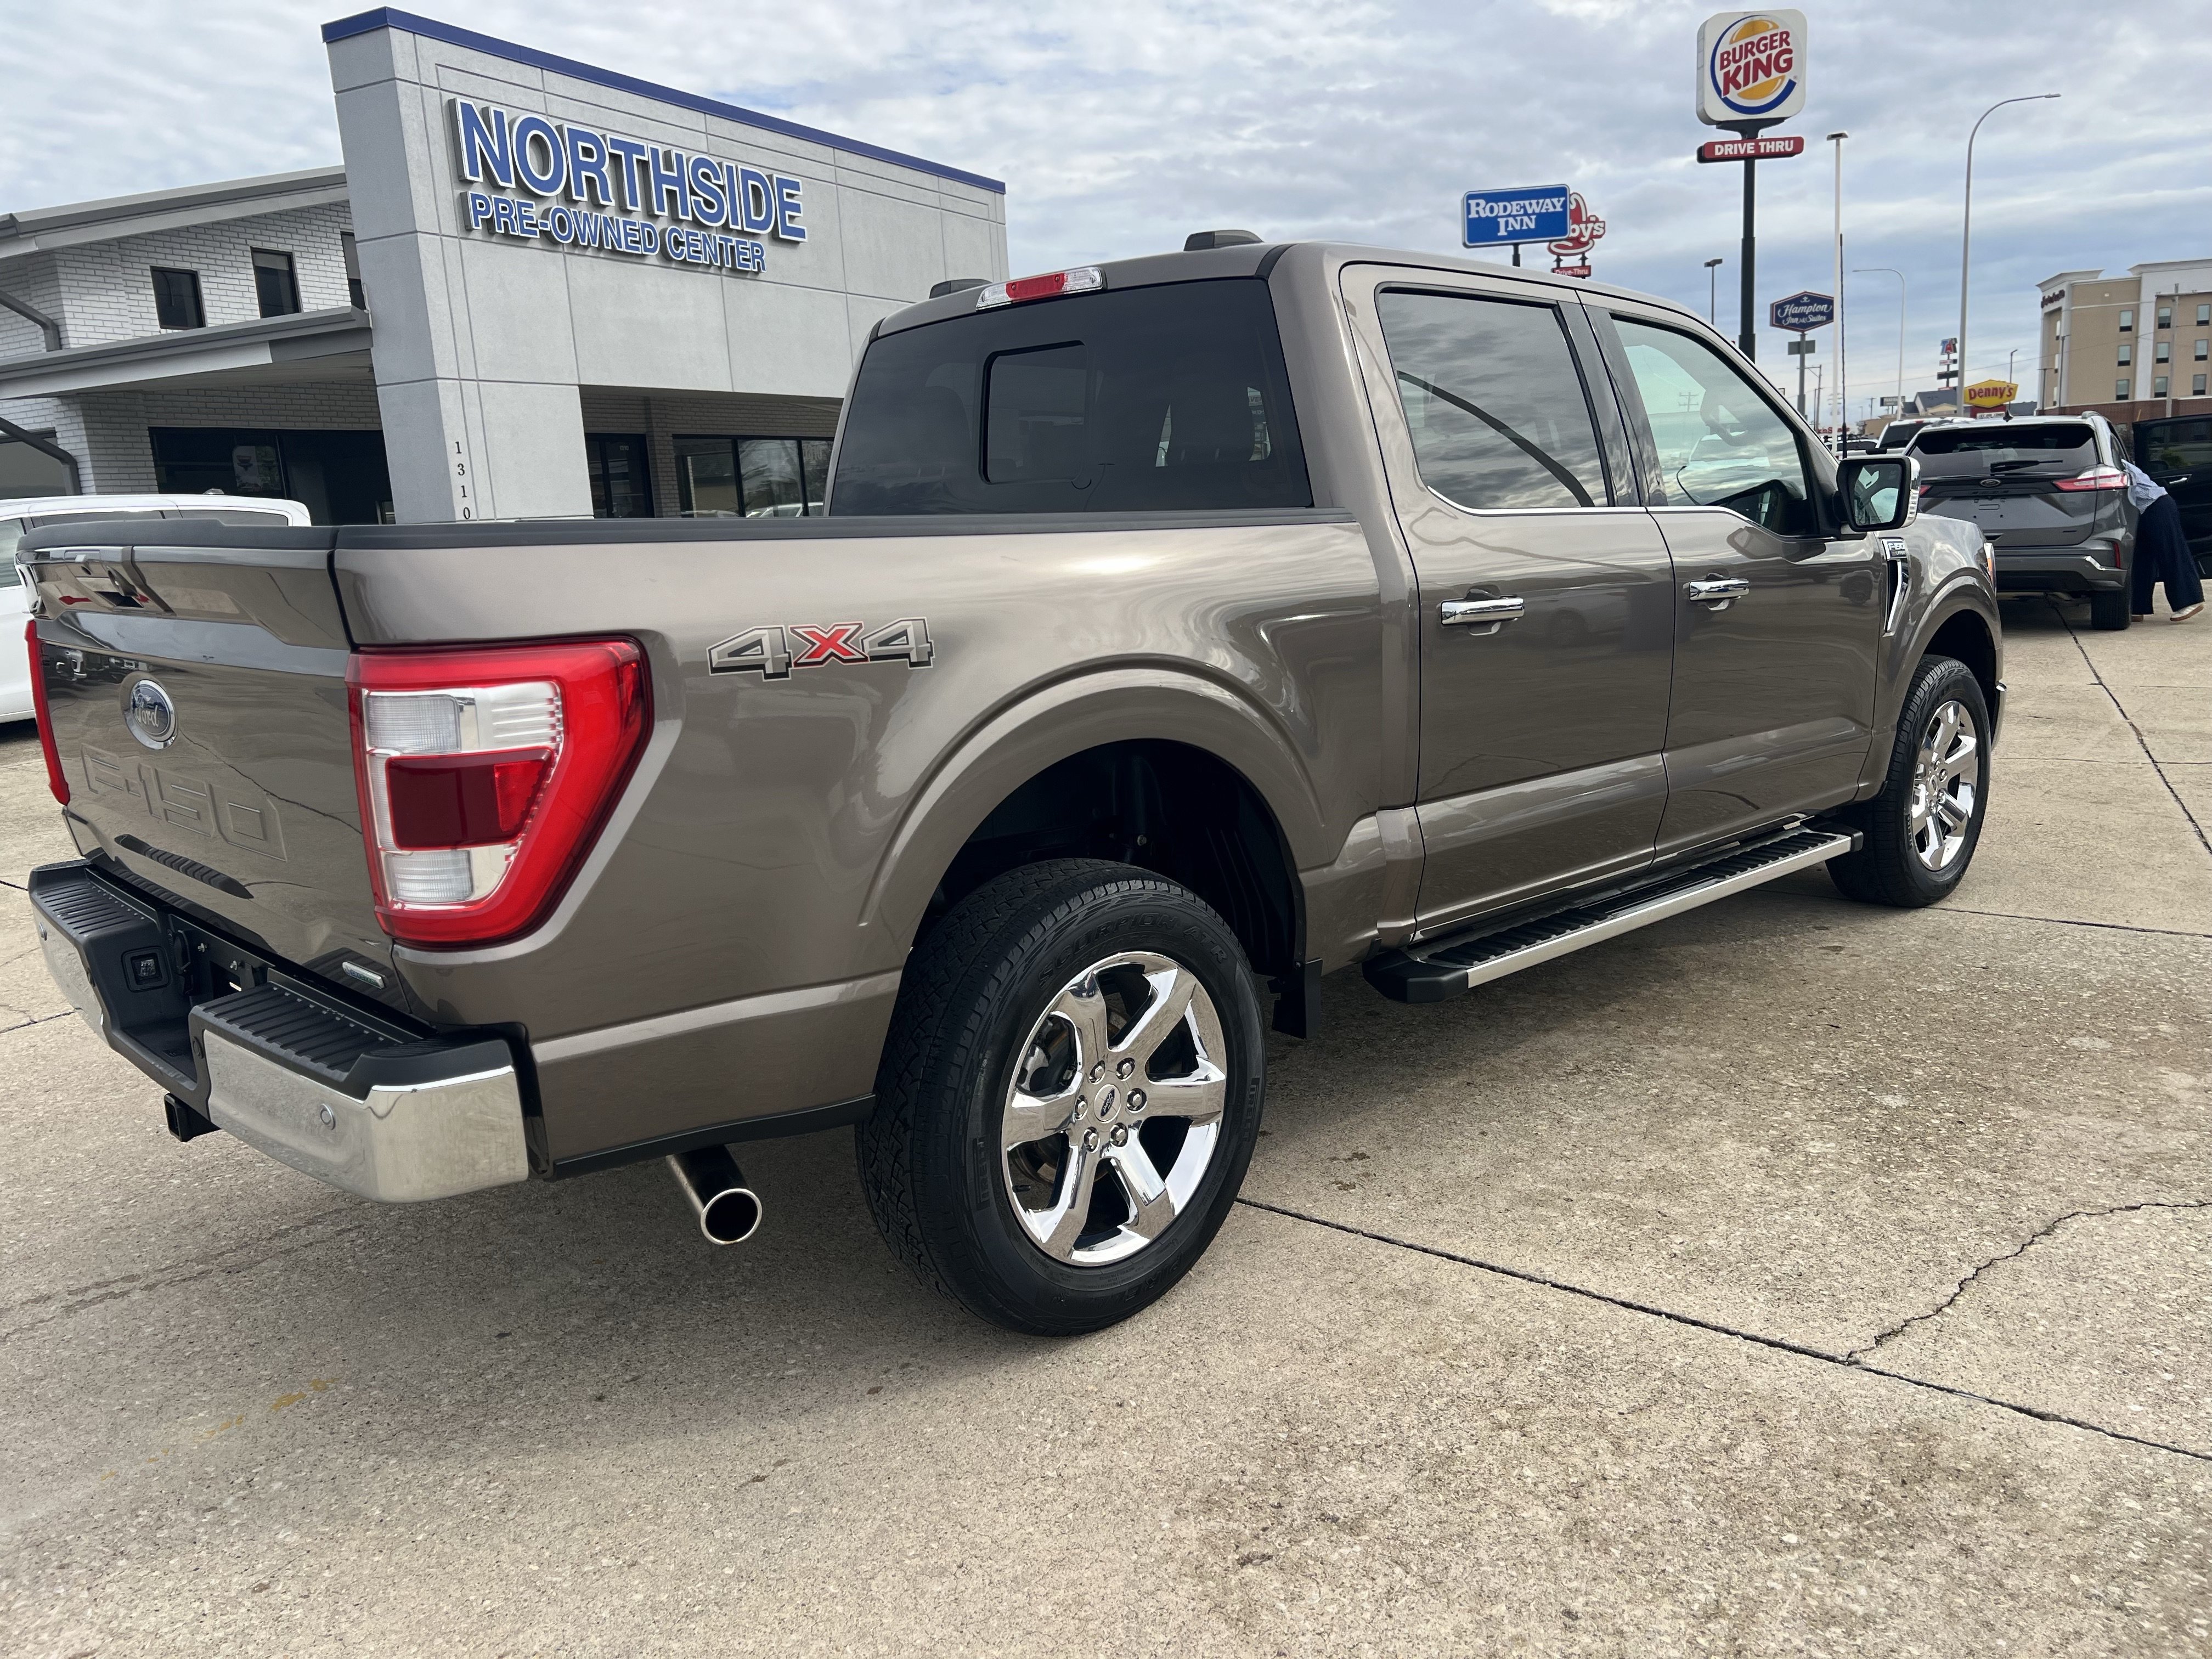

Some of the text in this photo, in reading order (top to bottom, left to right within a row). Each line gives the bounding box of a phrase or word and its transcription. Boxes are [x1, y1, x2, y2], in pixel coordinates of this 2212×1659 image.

[1720, 31, 1790, 71] BURGER
[1723, 48, 1793, 97] KING
[1714, 140, 1793, 156] DRIVE THRU
[451, 98, 808, 242] NORTHSIDE
[1468, 198, 1565, 218] RODEWAY
[465, 191, 766, 273] PRE-OWNED CENTER
[1497, 215, 1536, 236] INN
[1570, 216, 1605, 242] by's
[1778, 303, 1832, 318] Hampton
[1782, 317, 1800, 325] Inn
[1806, 314, 1827, 323] Suites
[1968, 385, 2013, 400] Denny's
[1037, 912, 1179, 988] SCORPION
[1183, 926, 1228, 964] ATR
